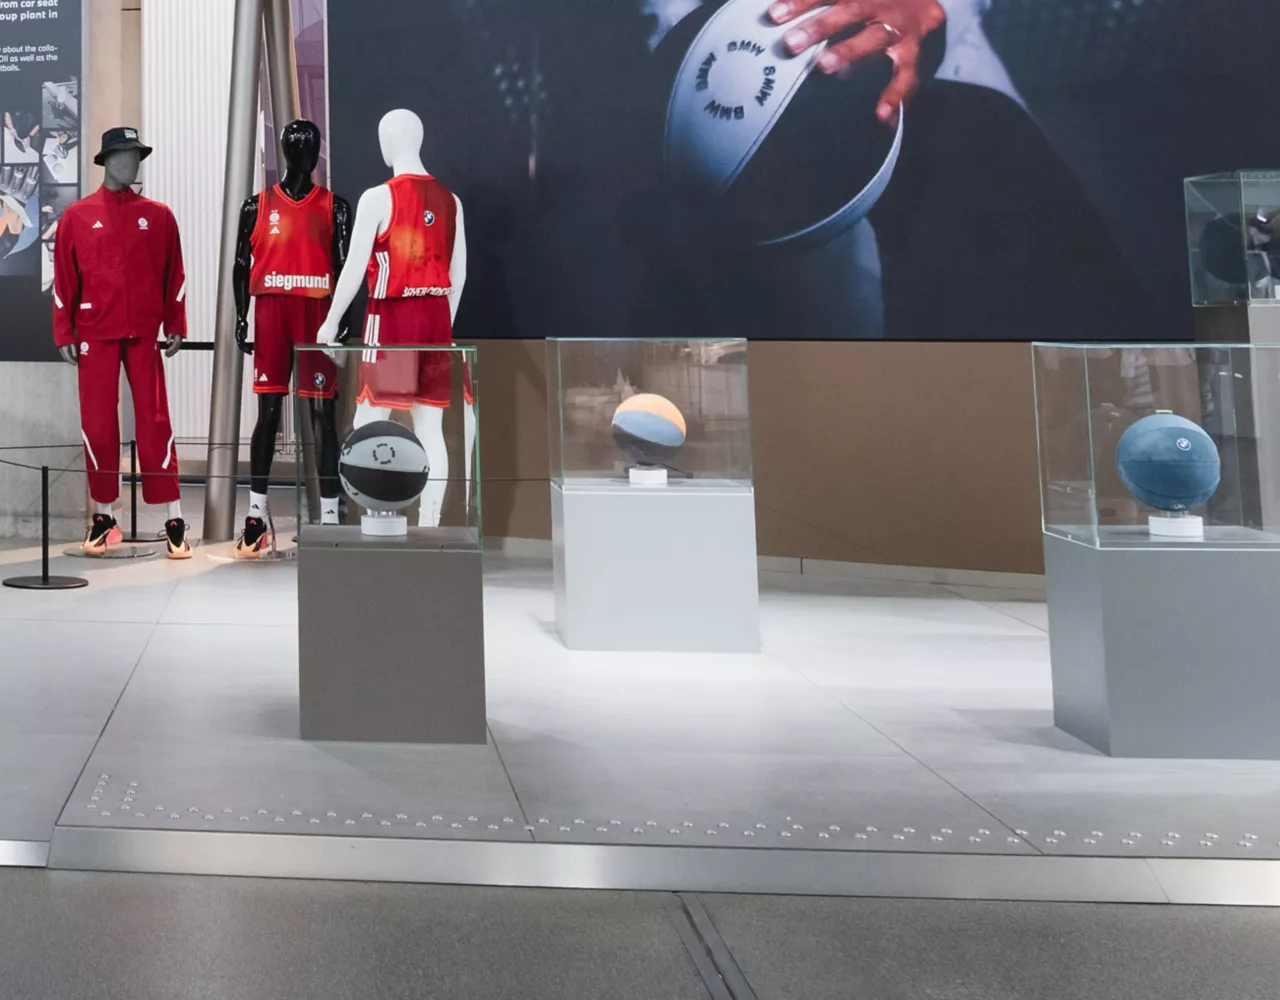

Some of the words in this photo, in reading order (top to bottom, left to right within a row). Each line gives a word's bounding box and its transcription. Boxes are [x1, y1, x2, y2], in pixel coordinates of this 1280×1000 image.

[20, 11, 46, 21] plant
[48, 10, 58, 18] in
[38, 44, 58, 52] colla-
[727, 40, 766, 56] BMW
[20, 54, 34, 62] well
[754, 66, 776, 107] BMW
[704, 100, 744, 121] BMW
[264, 271, 330, 290] siegmund
